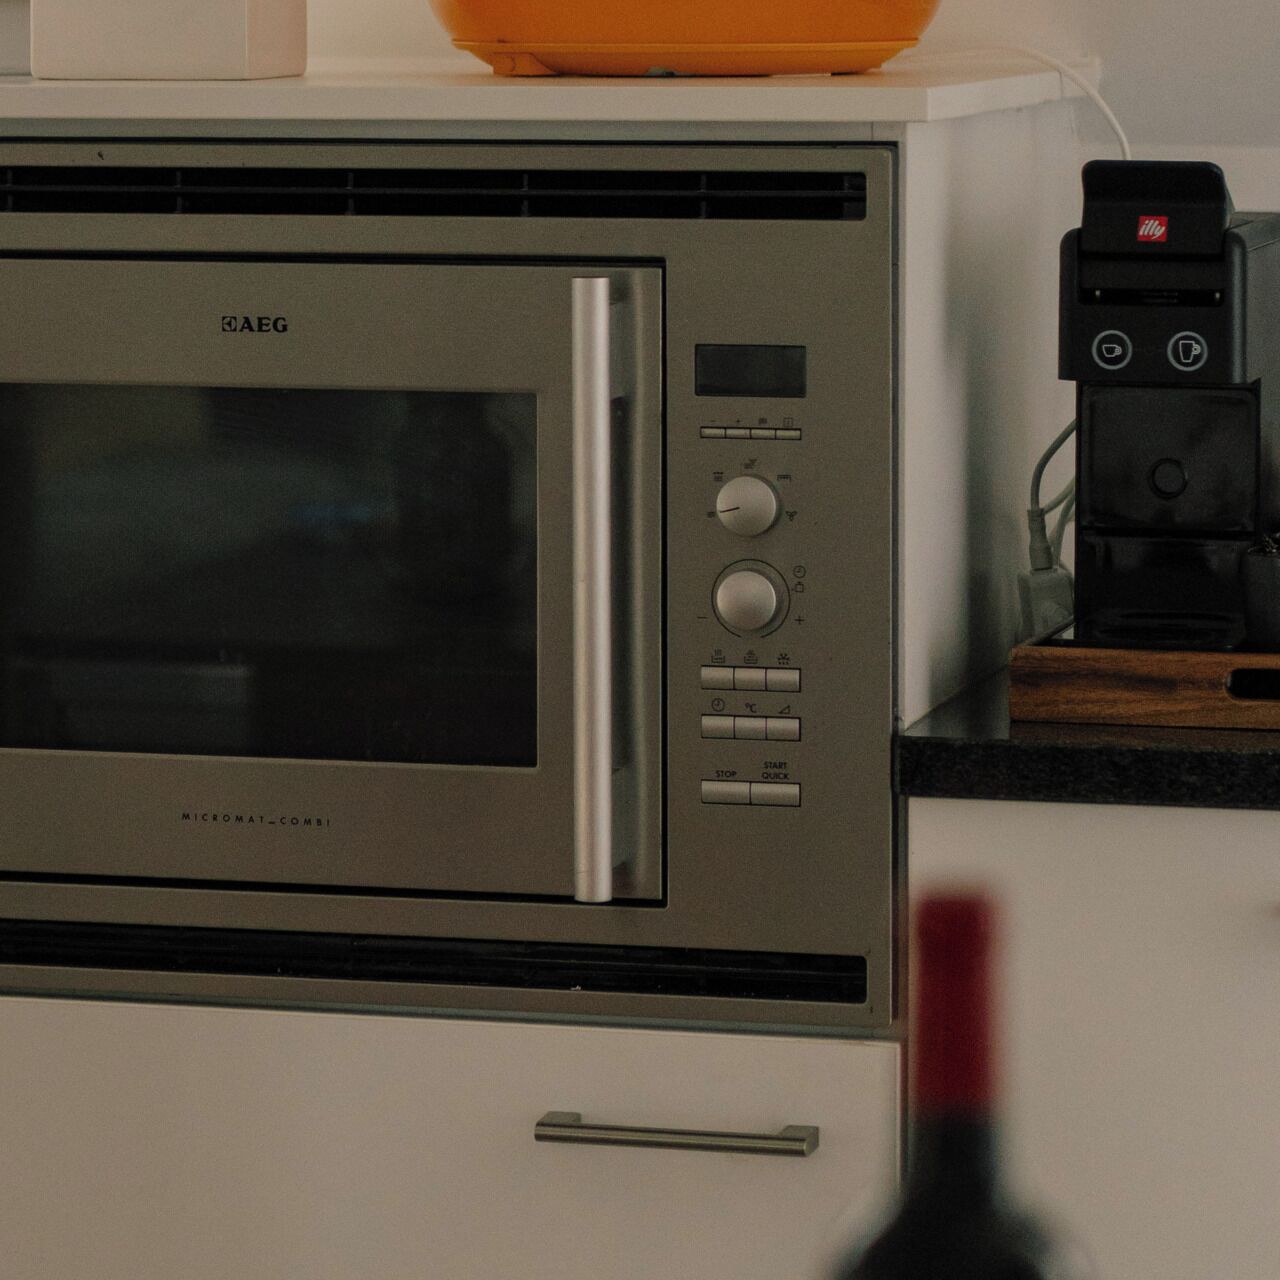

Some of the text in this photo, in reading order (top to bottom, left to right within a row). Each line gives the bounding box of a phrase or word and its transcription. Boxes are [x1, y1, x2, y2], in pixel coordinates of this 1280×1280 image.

[1139, 220, 1166, 240] illy
[239, 316, 288, 333] AEG
[763, 761, 787, 769] START
[715, 770, 737, 778] STOP
[761, 771, 789, 780] QUICK
